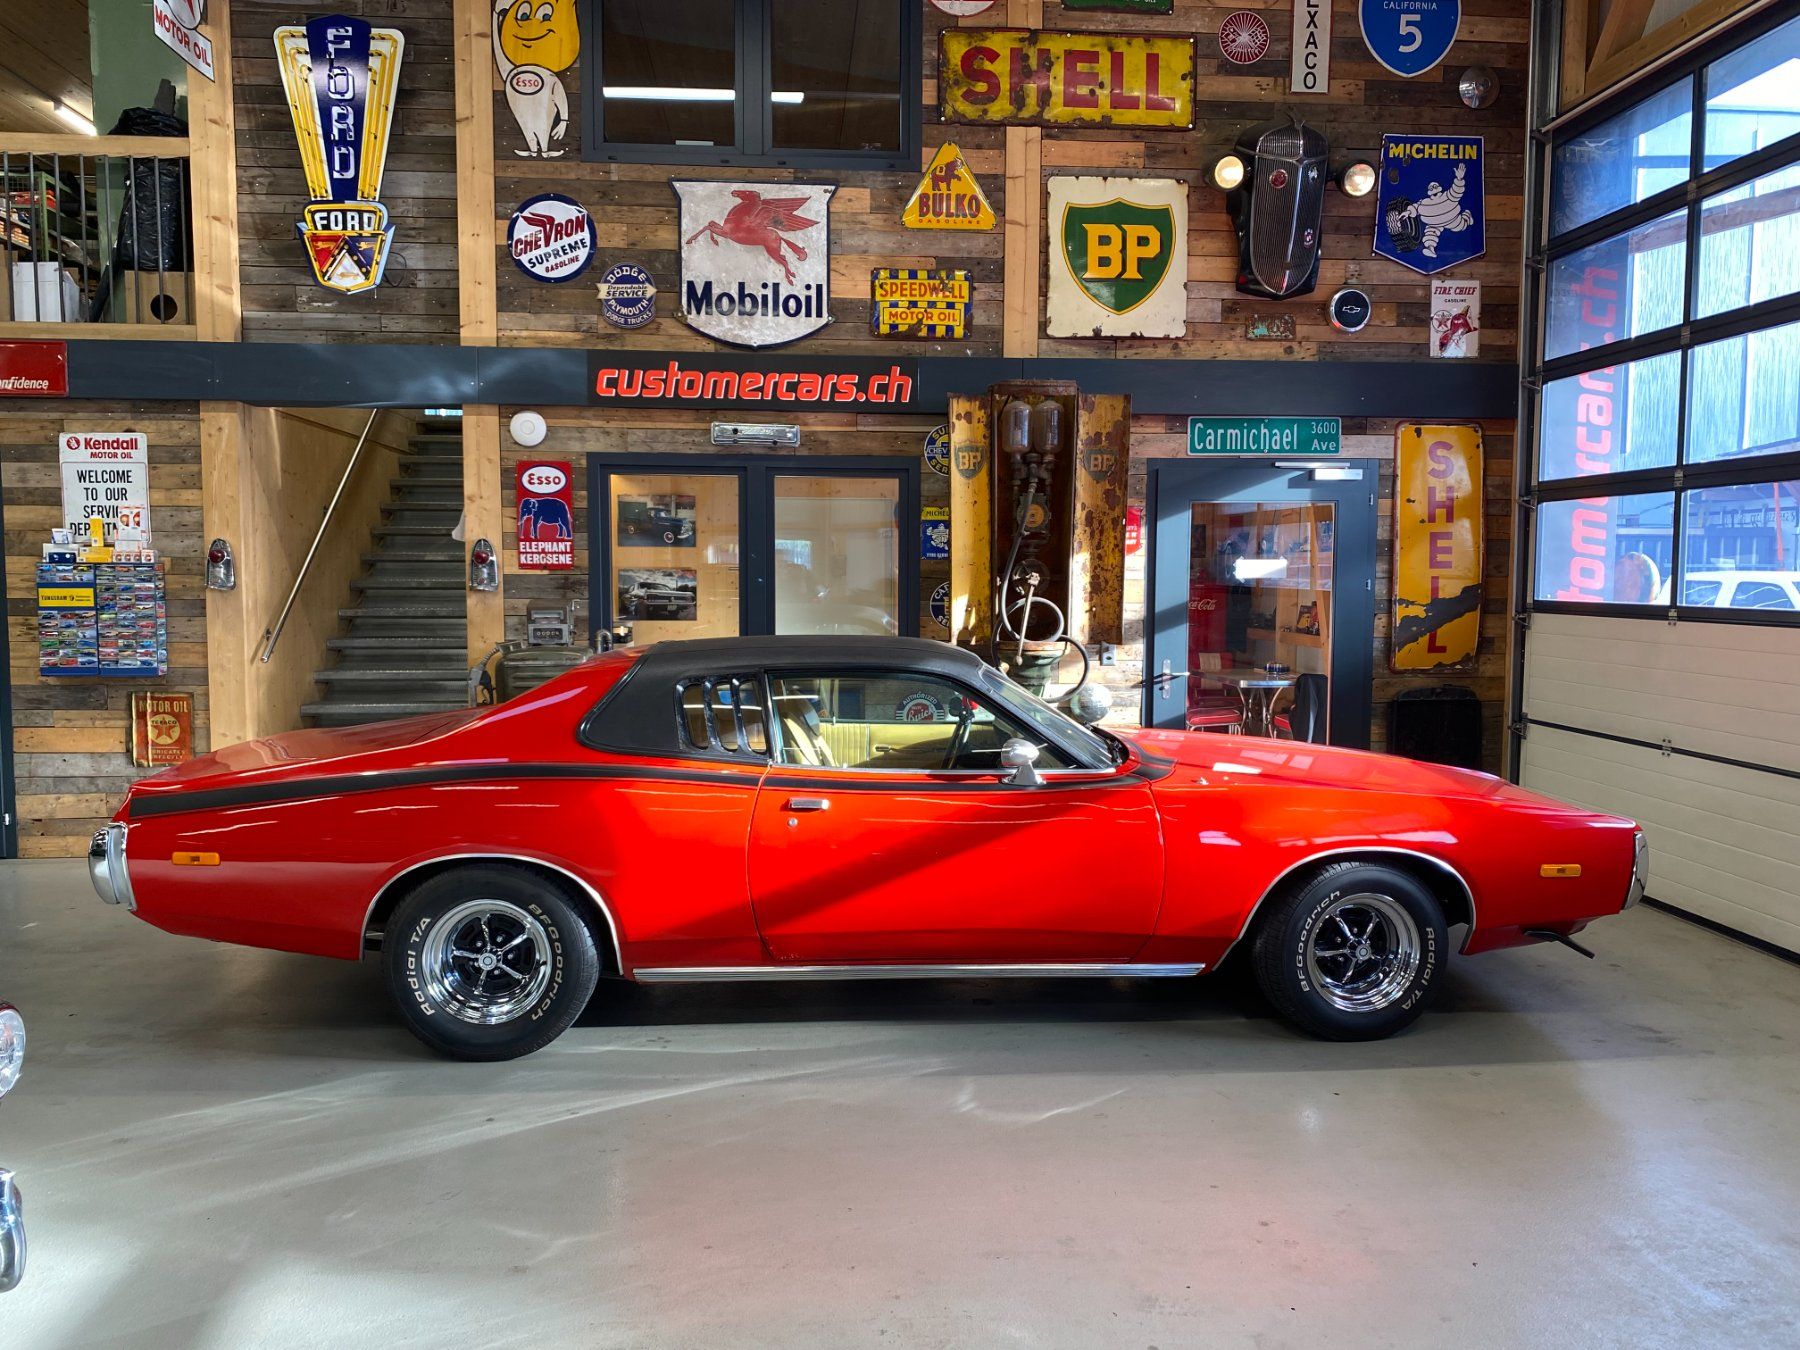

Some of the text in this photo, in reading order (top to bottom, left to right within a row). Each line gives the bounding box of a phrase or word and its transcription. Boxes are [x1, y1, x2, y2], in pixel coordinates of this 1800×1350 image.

[1383, 0, 1438, 11] CALIFORNIA
[155, 5, 211, 68] MOTOR OIL
[1398, 14, 1423, 53] 5
[960, 46, 1176, 112] SHELL
[327, 26, 356, 179] FORD
[1389, 143, 1478, 160] MICHELIN
[919, 192, 981, 219] BULKO
[313, 212, 375, 231] FORD
[513, 212, 587, 258] CHEVRON
[528, 238, 588, 269] SUPREME
[1081, 223, 1161, 281] BP
[545, 255, 580, 273] GASOLINE
[606, 267, 647, 284] DODGE
[687, 280, 823, 319] Mobiloil
[879, 281, 965, 300] SPEEDWELL
[1434, 286, 1477, 296] FIRE CHIEF
[608, 299, 650, 316] PLYMOUTH
[888, 310, 958, 323] MOTOR OIL
[606, 311, 652, 325] DODGE TRUCKS
[0, 377, 49, 390] nfidence
[597, 361, 913, 404] customercars.ch
[84, 437, 139, 451] Kendall
[1194, 421, 1337, 450] Carmichael 3600
[1311, 439, 1337, 451] Ave
[958, 451, 982, 471] BP
[1090, 453, 1115, 472] BP
[77, 469, 133, 484] WELCOME
[83, 488, 128, 501] TO OUR
[83, 505, 119, 519] SERVI
[519, 541, 572, 553] ELEPHANT
[1427, 440, 1455, 655] SHELL
[520, 553, 573, 565] KEROSENE
[1188, 599, 1218, 611] ca-Cola
[139, 700, 188, 713] MOTOR OIL
[902, 692, 938, 706] AUTHORIZED
[406, 916, 435, 1016] Radial T/A
[1401, 927, 1436, 1011] Radial T/A
